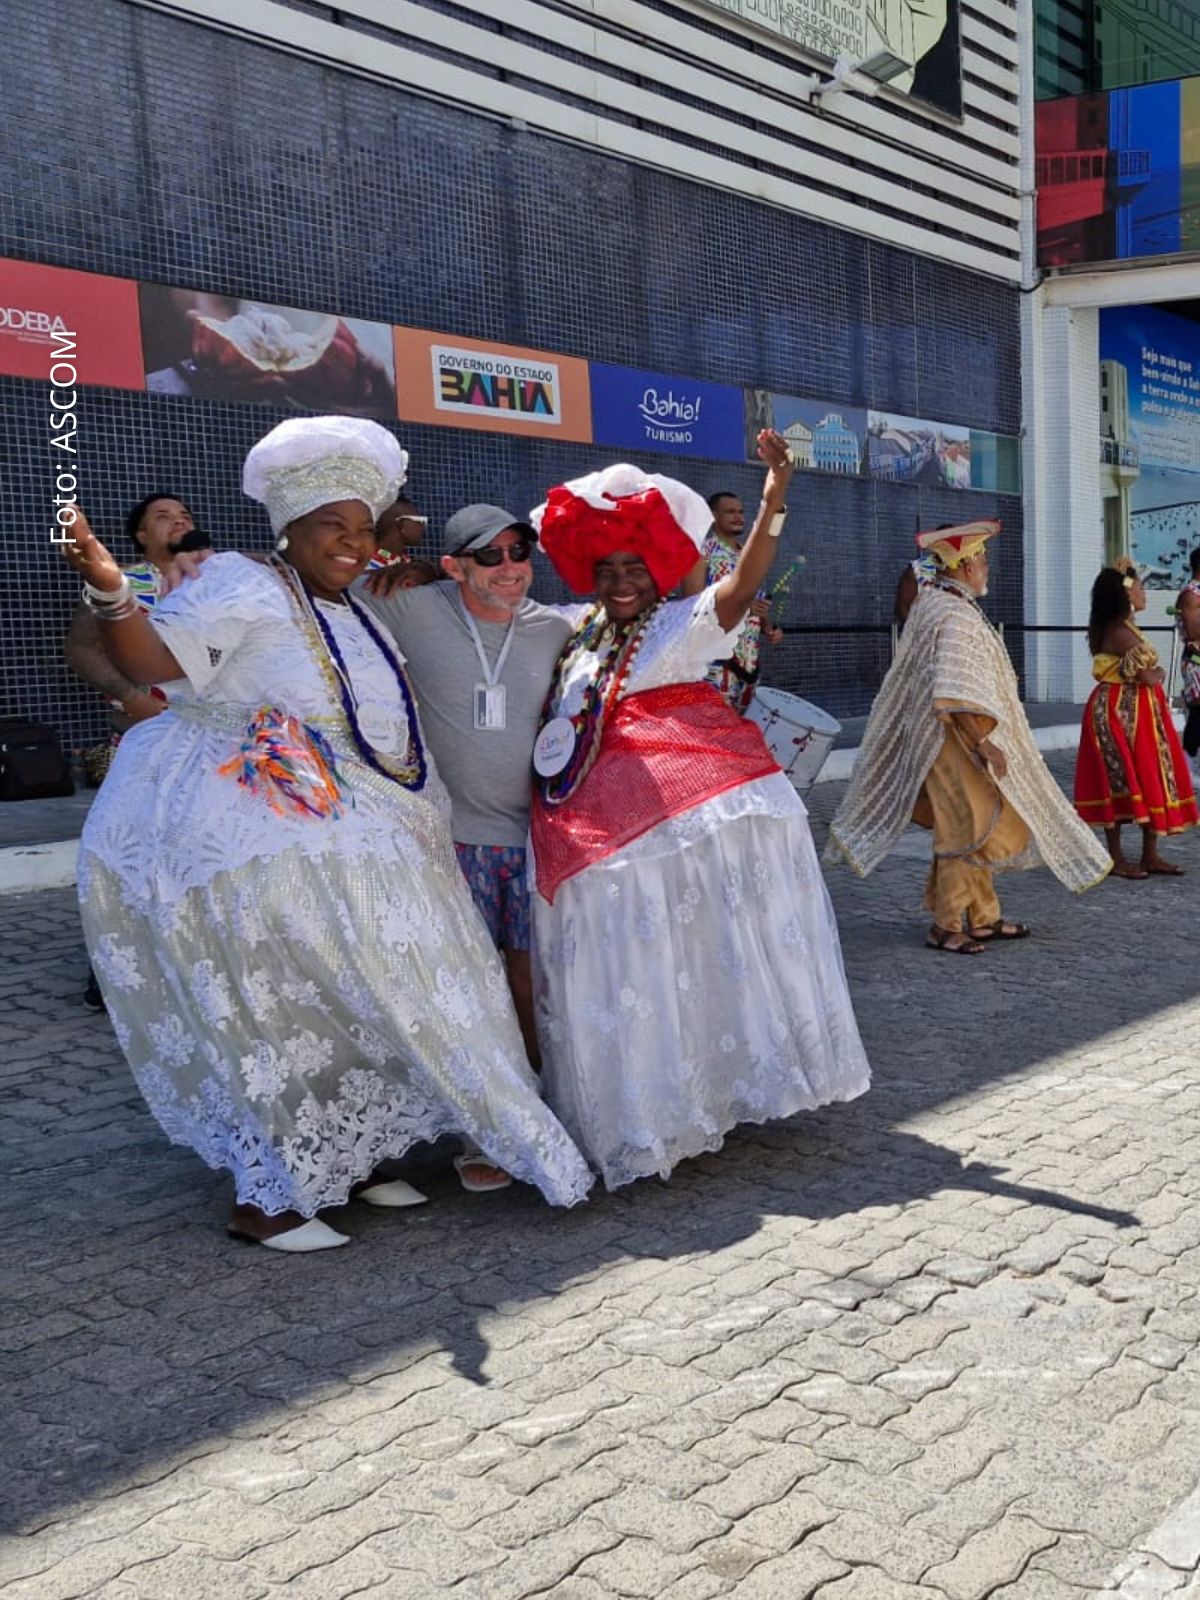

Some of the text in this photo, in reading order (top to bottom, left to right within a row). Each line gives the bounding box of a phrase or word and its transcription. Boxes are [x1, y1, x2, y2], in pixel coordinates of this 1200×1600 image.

[439, 354, 553, 383] GOVERNO DO ESTADO
[1179, 360, 1193, 373] que
[440, 367, 554, 416] BAHIA
[638, 388, 701, 422] Bahia!
[645, 425, 693, 443] TURISMO
